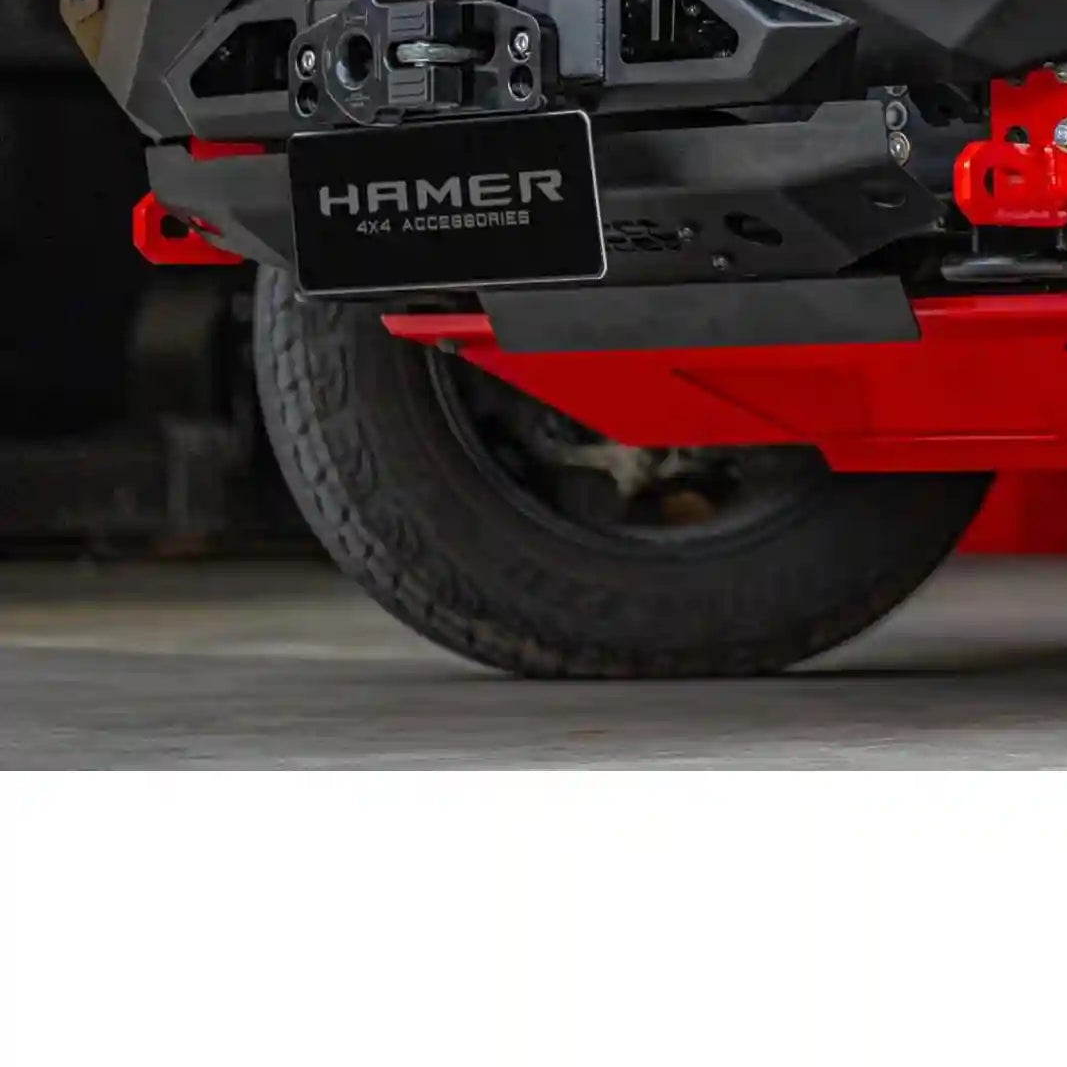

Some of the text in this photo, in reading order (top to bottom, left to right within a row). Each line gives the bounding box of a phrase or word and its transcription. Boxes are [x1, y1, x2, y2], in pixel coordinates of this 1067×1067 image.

[319, 169, 564, 217] HAMER
[356, 210, 530, 234] 4X4 ACCESSORIES
